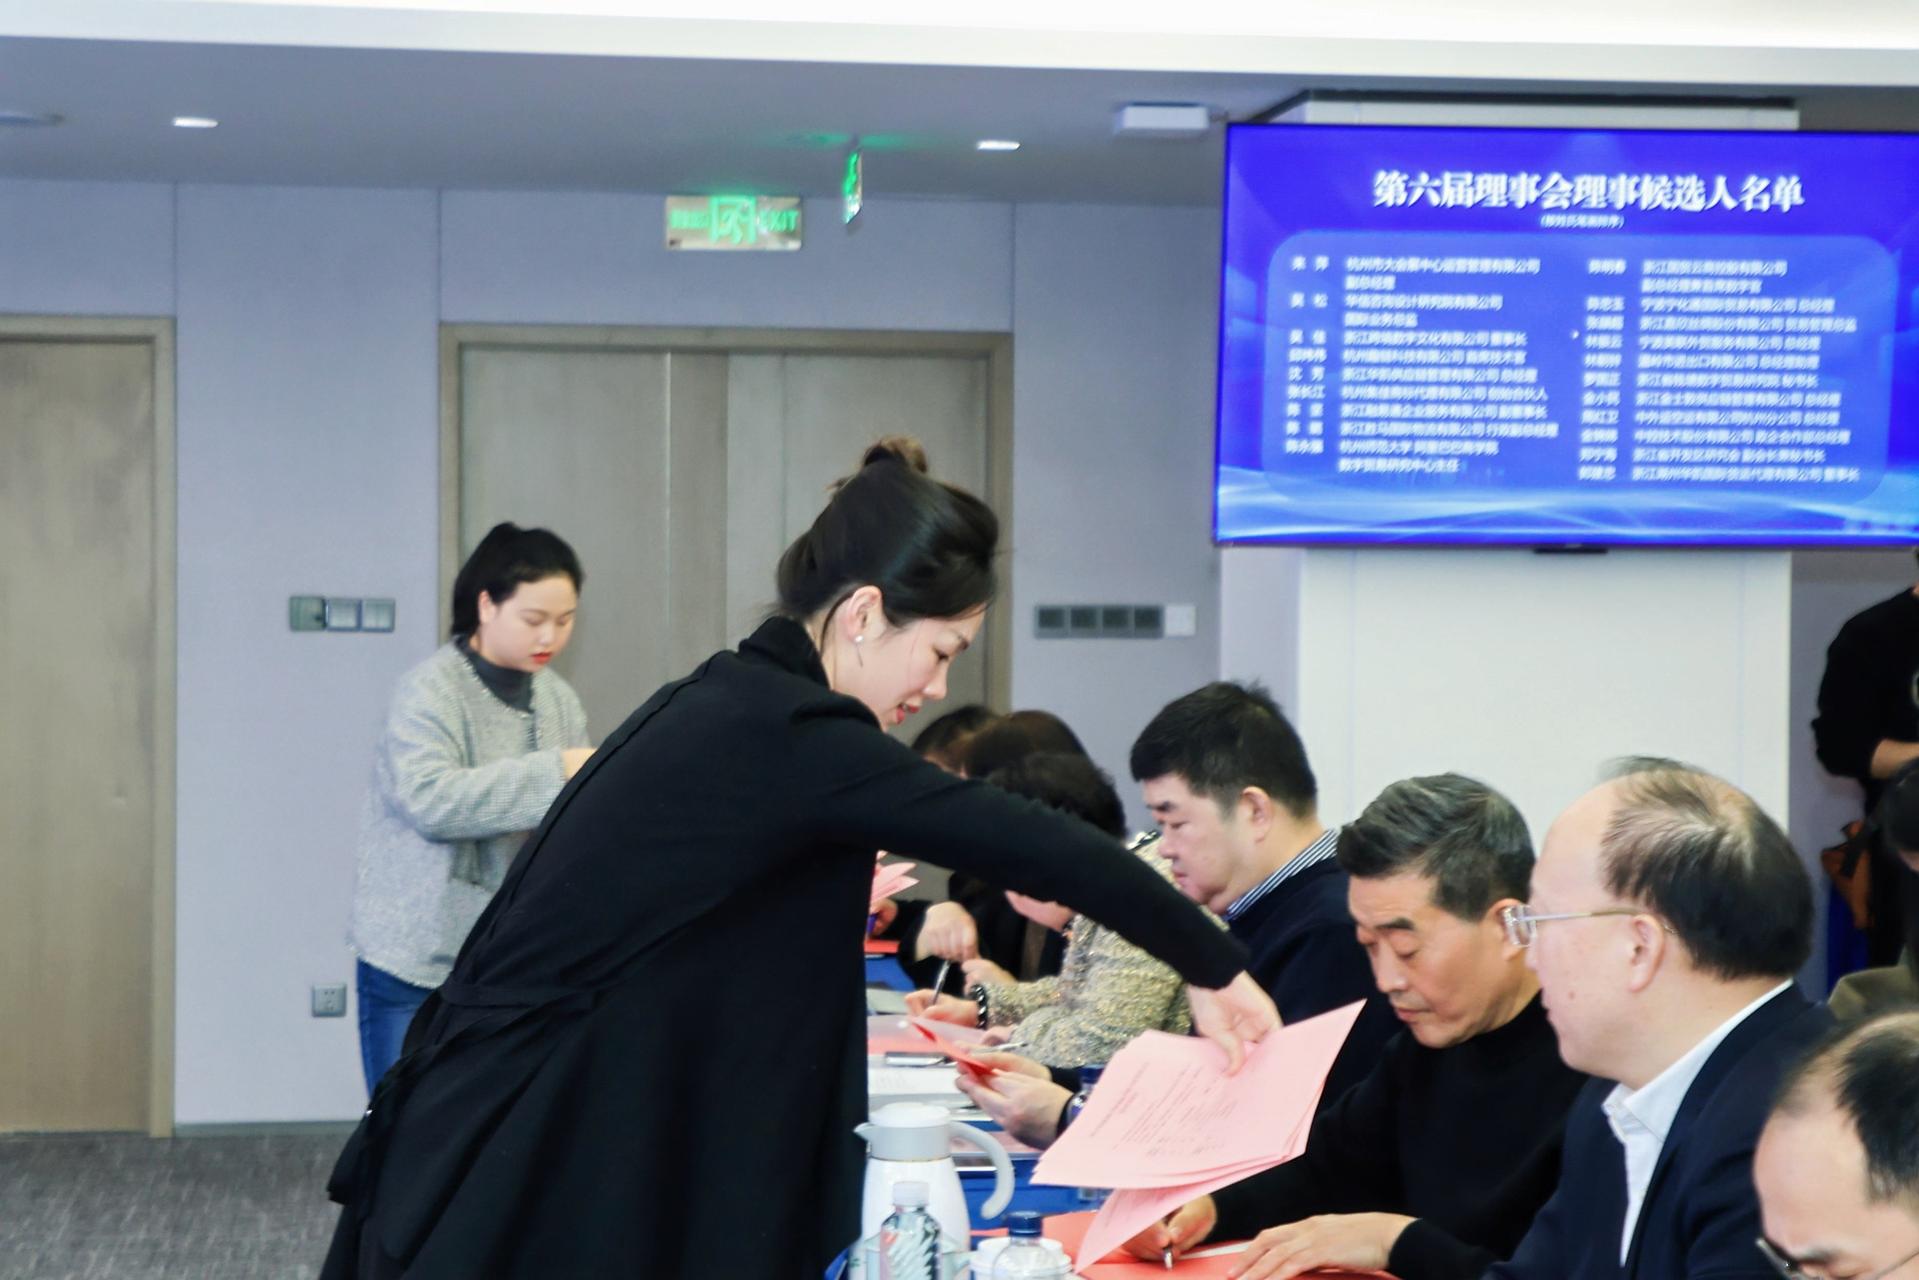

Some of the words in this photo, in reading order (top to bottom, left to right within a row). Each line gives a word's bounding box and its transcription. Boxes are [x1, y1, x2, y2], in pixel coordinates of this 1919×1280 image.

[1373, 169, 1805, 212] 第六届理事会理事候选人名单
[1345, 276, 1395, 289] 副总经理
[1798, 299, 1834, 312] 总经理
[1490, 332, 1525, 345] 董事长
[1785, 337, 1820, 350] 总经理
[1501, 368, 1537, 383] 总经理
[1782, 375, 1815, 387] 秘书长
[1805, 393, 1840, 406] 总经理
[1498, 405, 1546, 419] 副董事长
[1804, 412, 1839, 424] 总经理
[1340, 440, 1412, 453] 杭州师范大学
[1414, 440, 1498, 454] 阿里巴巴商学院
[1339, 458, 1458, 472] 数字贸易研究中心主任
[1824, 468, 1857, 480] 董事长
